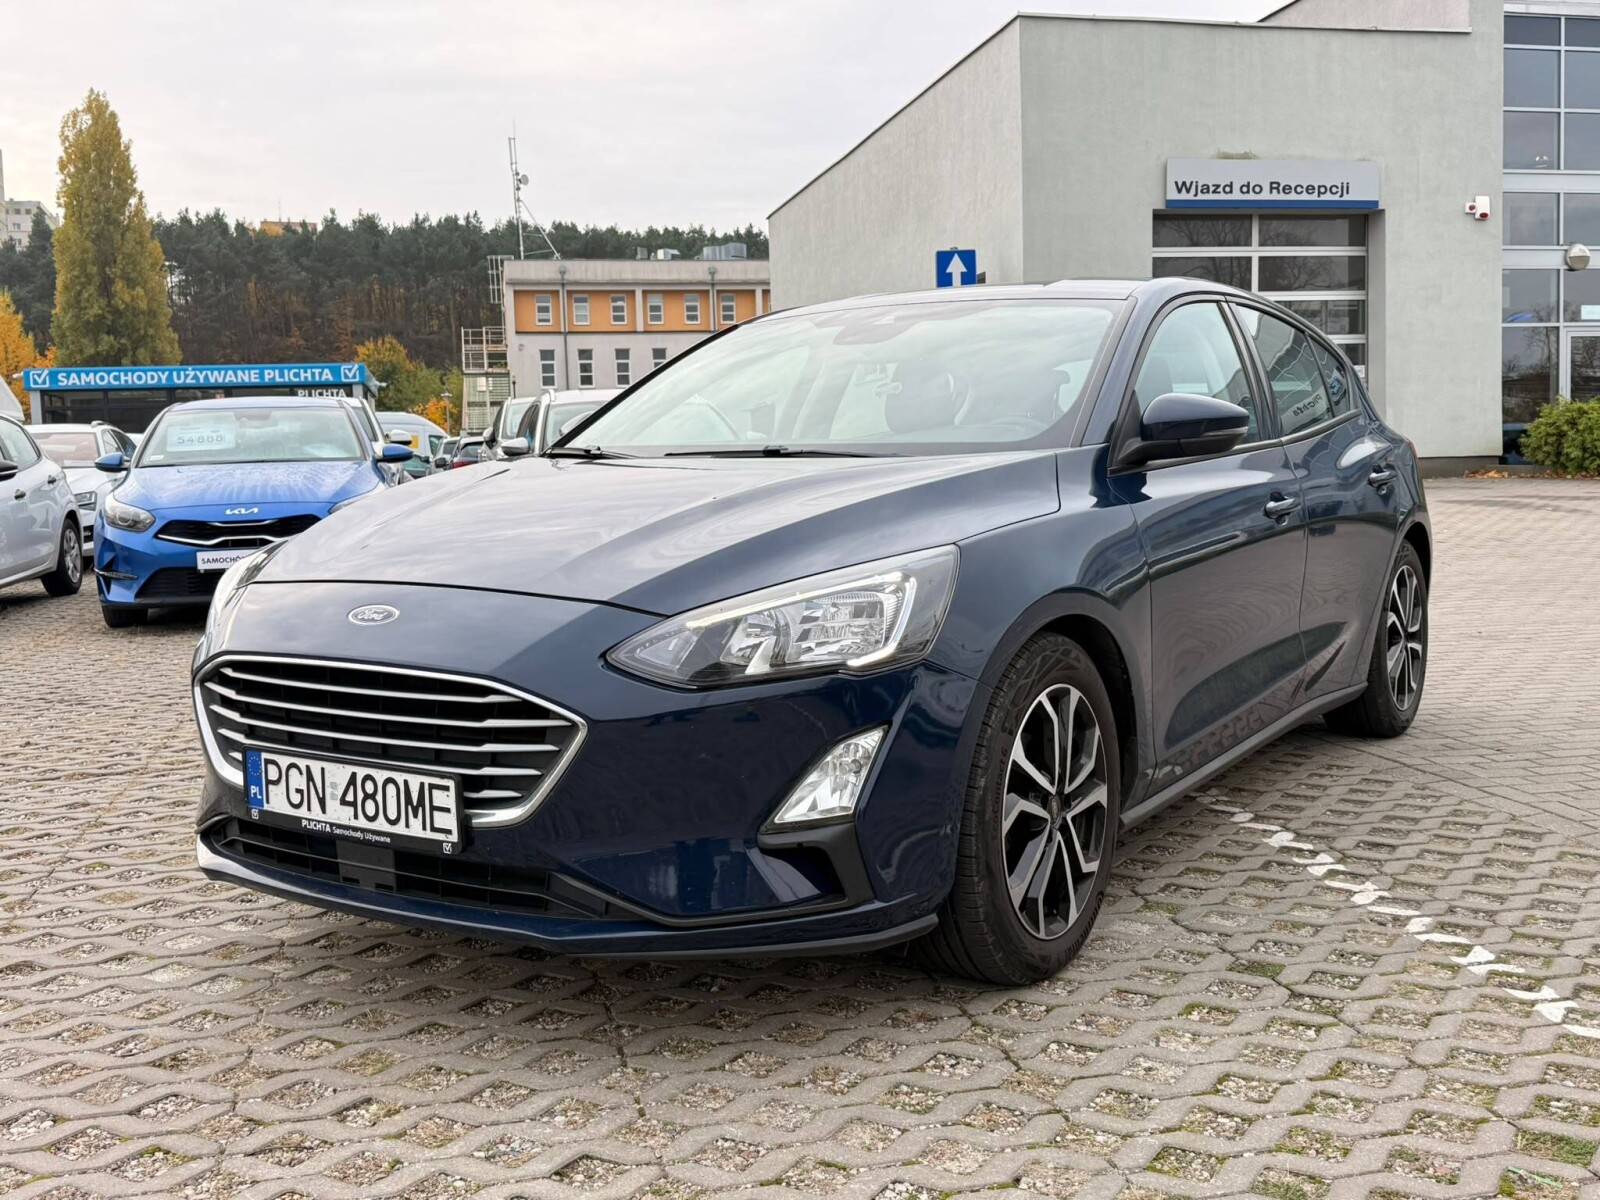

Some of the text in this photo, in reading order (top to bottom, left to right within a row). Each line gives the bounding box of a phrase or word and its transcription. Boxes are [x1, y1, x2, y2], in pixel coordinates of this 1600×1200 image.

[1174, 180, 1350, 198] Wjazd do Recepcji
[57, 367, 333, 386] SAMOCHODY UŻYWANE PLICHTA
[225, 507, 259, 515] KIA
[201, 555, 245, 564] SAMOCHÓ
[355, 607, 391, 622] Ford
[250, 786, 262, 799] PL
[263, 758, 453, 835] PGN 480ME
[302, 819, 391, 843] PLICHTA Samochody Używane
